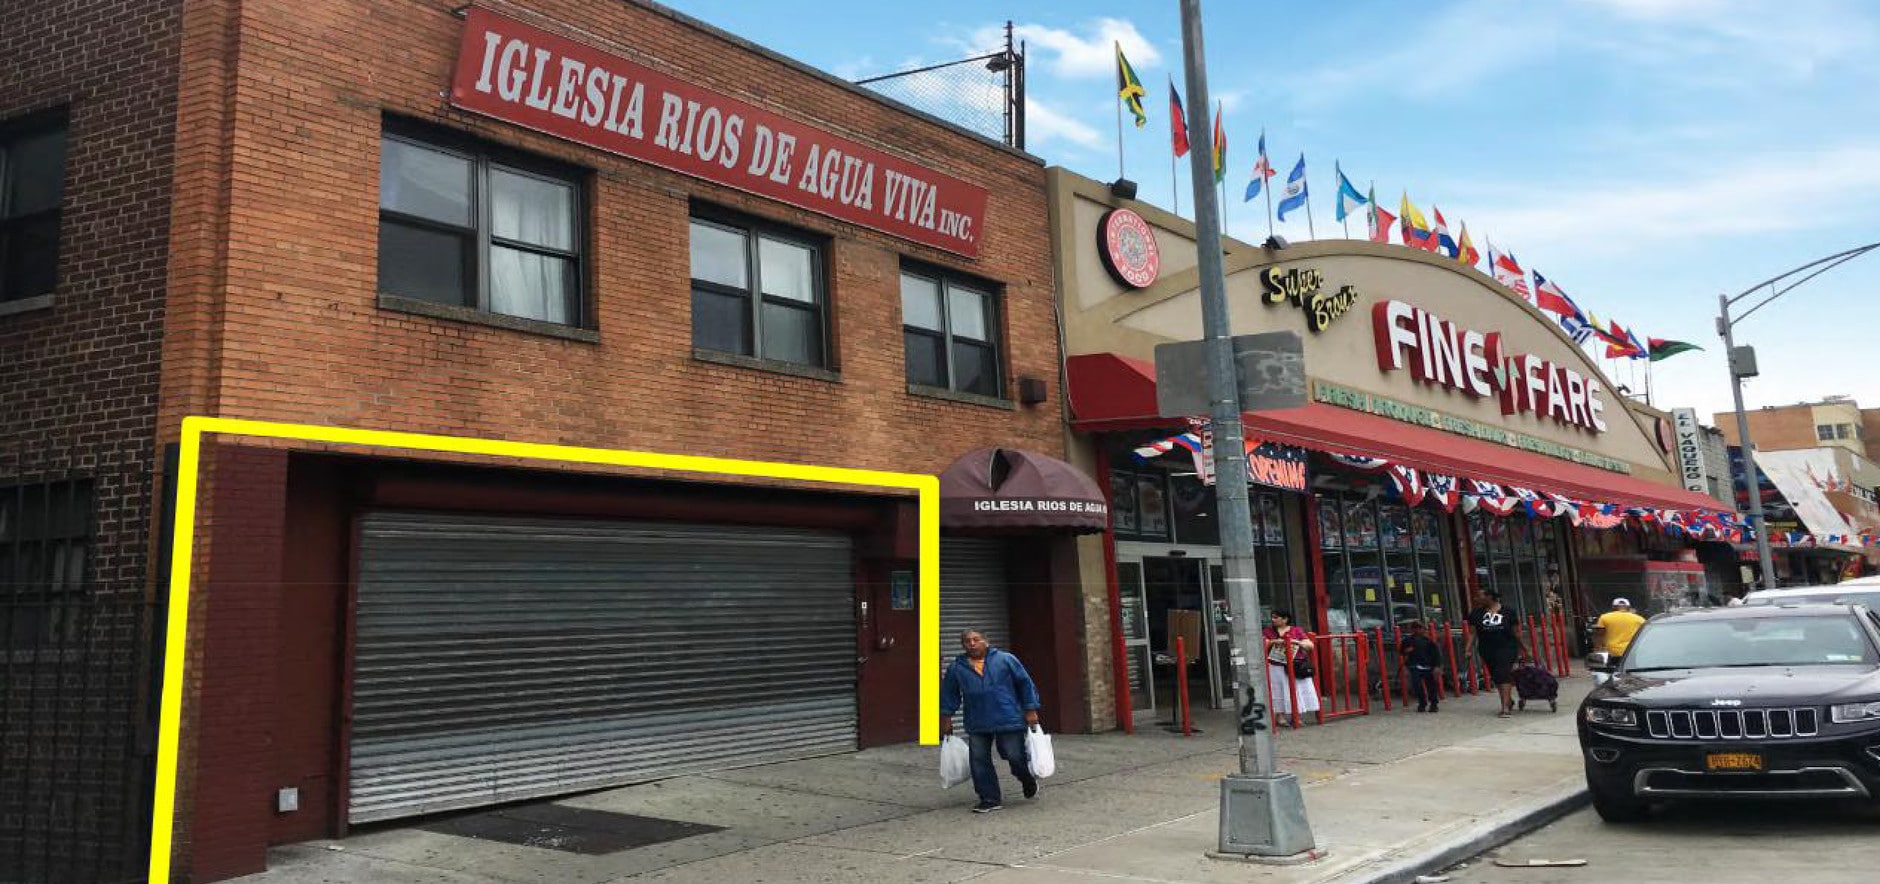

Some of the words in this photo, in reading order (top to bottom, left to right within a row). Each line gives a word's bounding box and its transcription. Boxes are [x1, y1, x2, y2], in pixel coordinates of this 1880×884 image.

[476, 31, 643, 139] IGLESIA
[655, 91, 744, 168] RIOS
[748, 126, 795, 183] DE
[799, 143, 873, 209] AGUA
[885, 170, 935, 229] VIVA
[939, 208, 973, 243] INC.
[1264, 265, 1323, 307] Super
[1378, 299, 1492, 398] FINE
[1522, 353, 1606, 433] FARE
[974, 500, 1034, 511] IGLESIA
[1038, 500, 1067, 511] RIOS
[1069, 501, 1083, 512] DE
